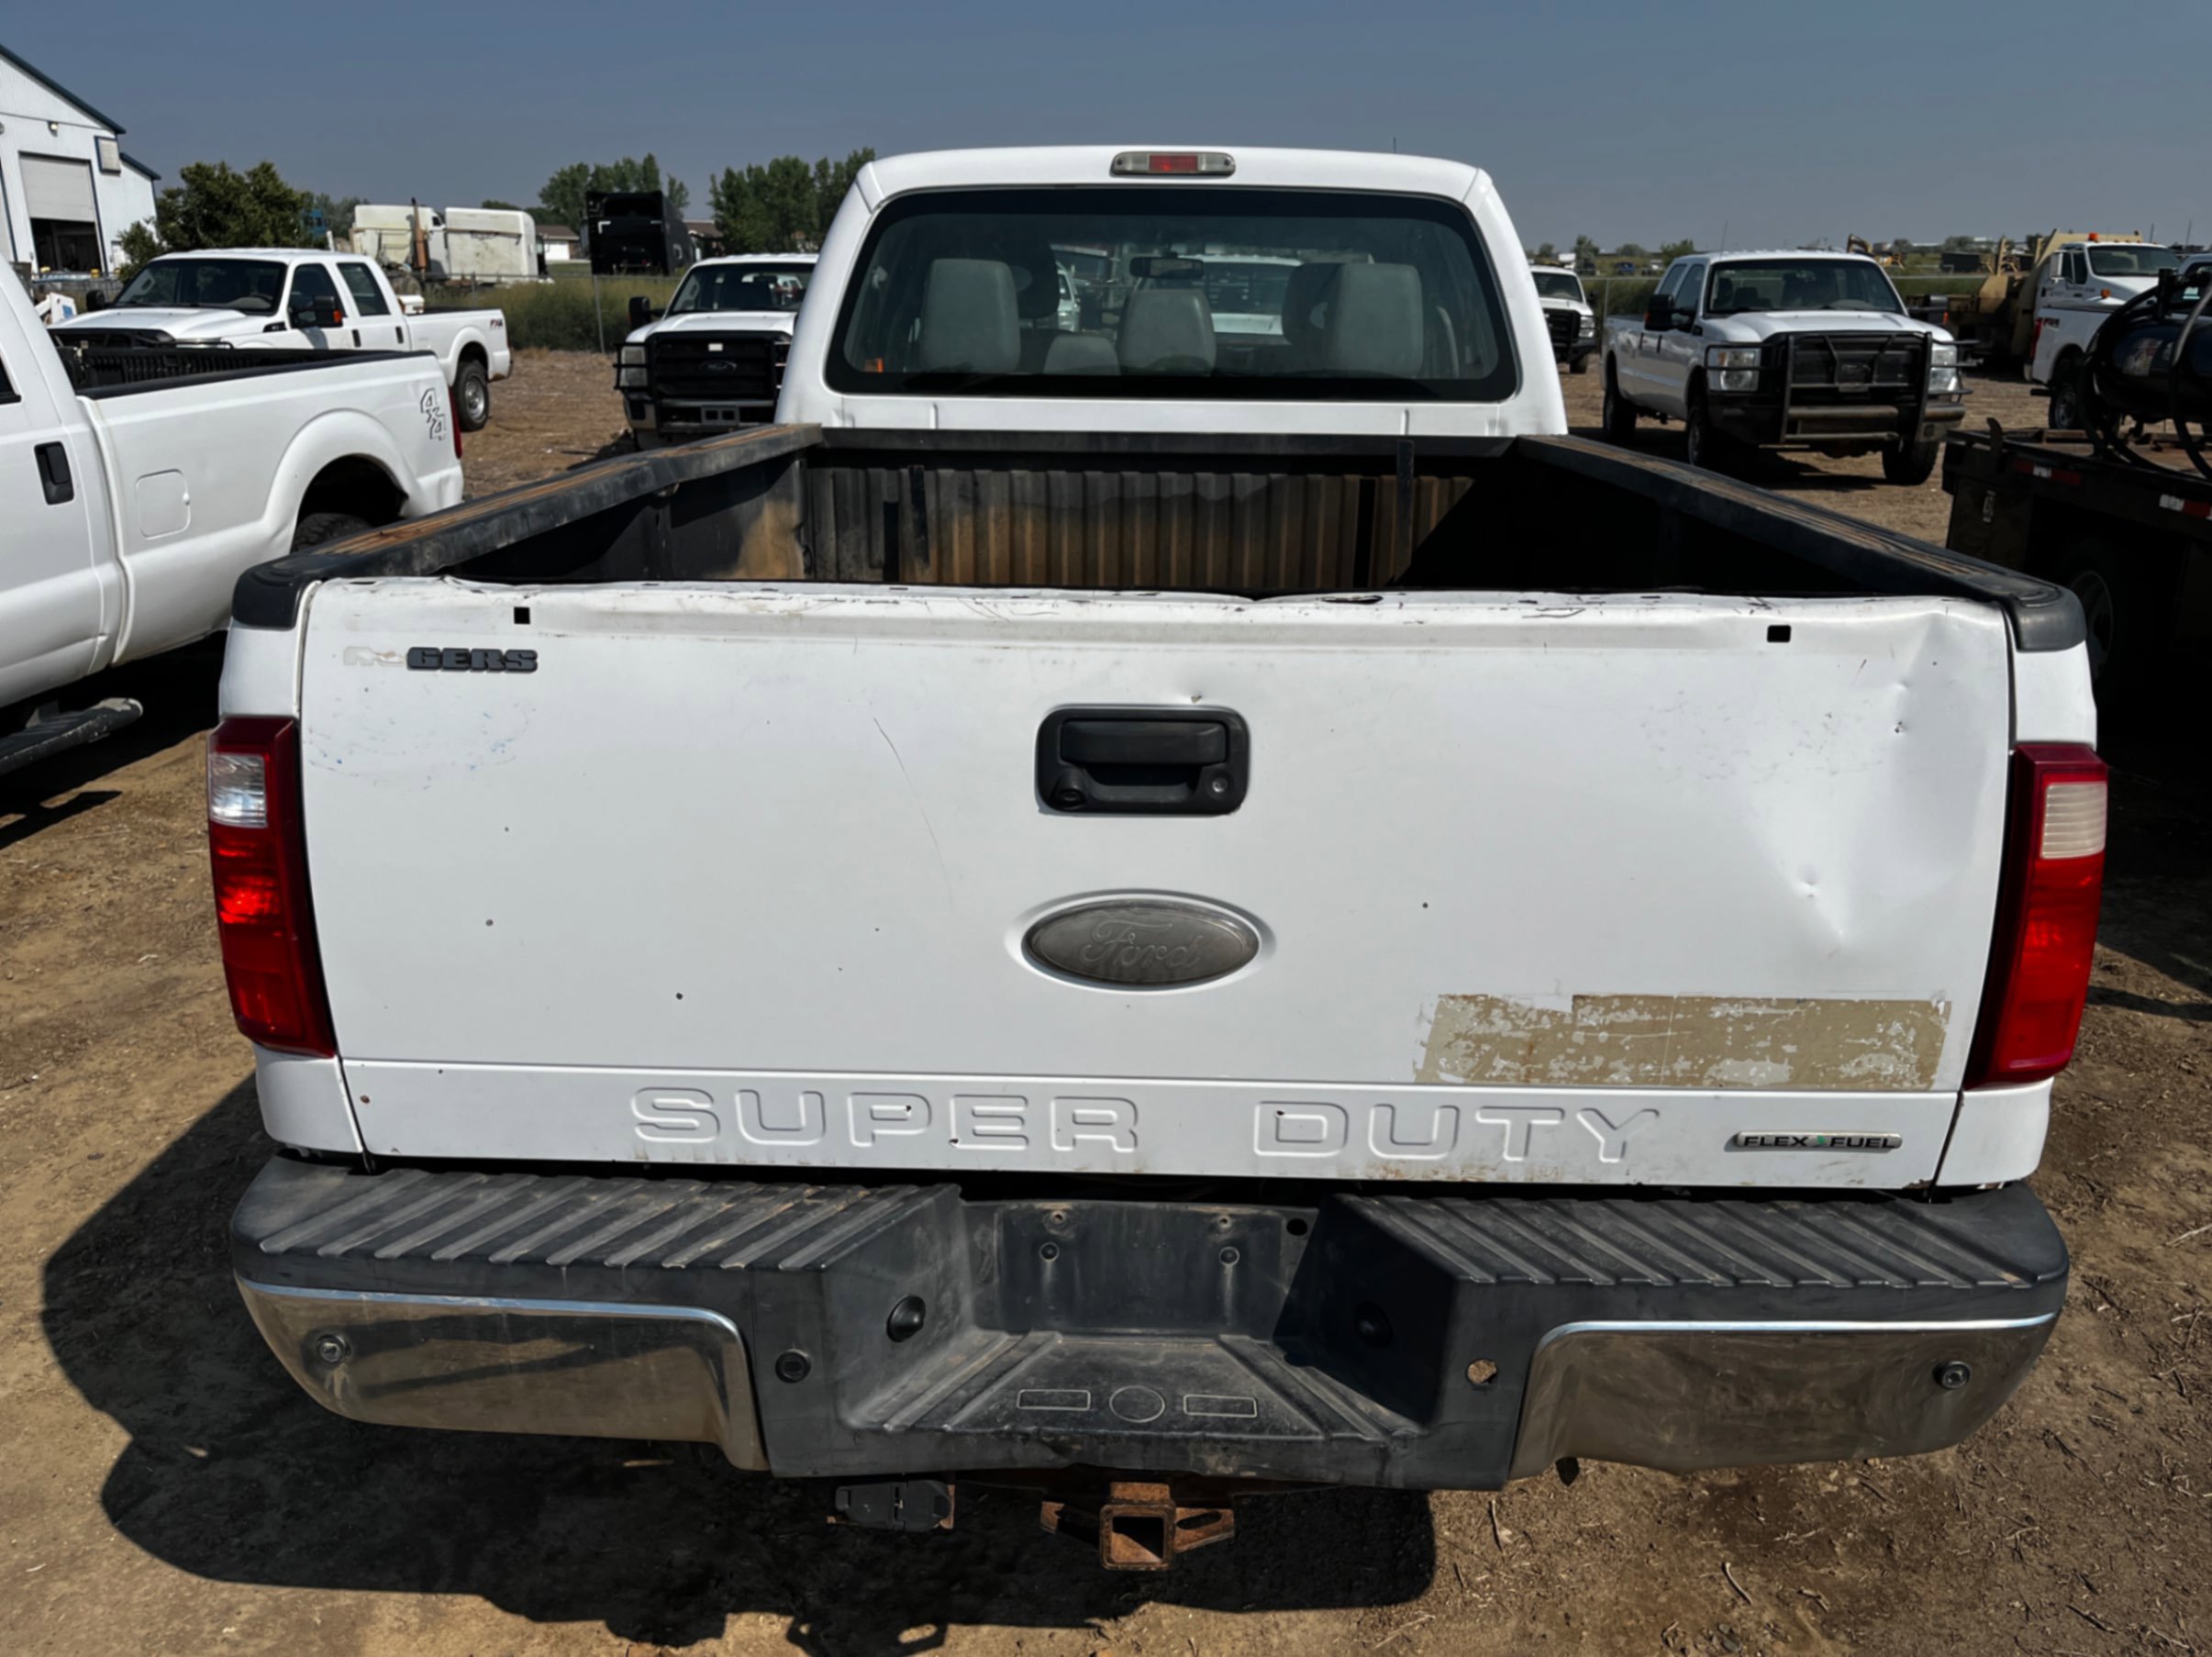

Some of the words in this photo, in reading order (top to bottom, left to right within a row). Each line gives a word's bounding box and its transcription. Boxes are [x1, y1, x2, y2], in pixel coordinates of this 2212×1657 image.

[1078, 919, 1204, 969] Ford
[631, 1087, 1138, 1152] SUPER
[1253, 1101, 1660, 1162] DUTY
[1743, 1135, 1809, 1147] FLEX
[1829, 1137, 1896, 1149] FUEL
